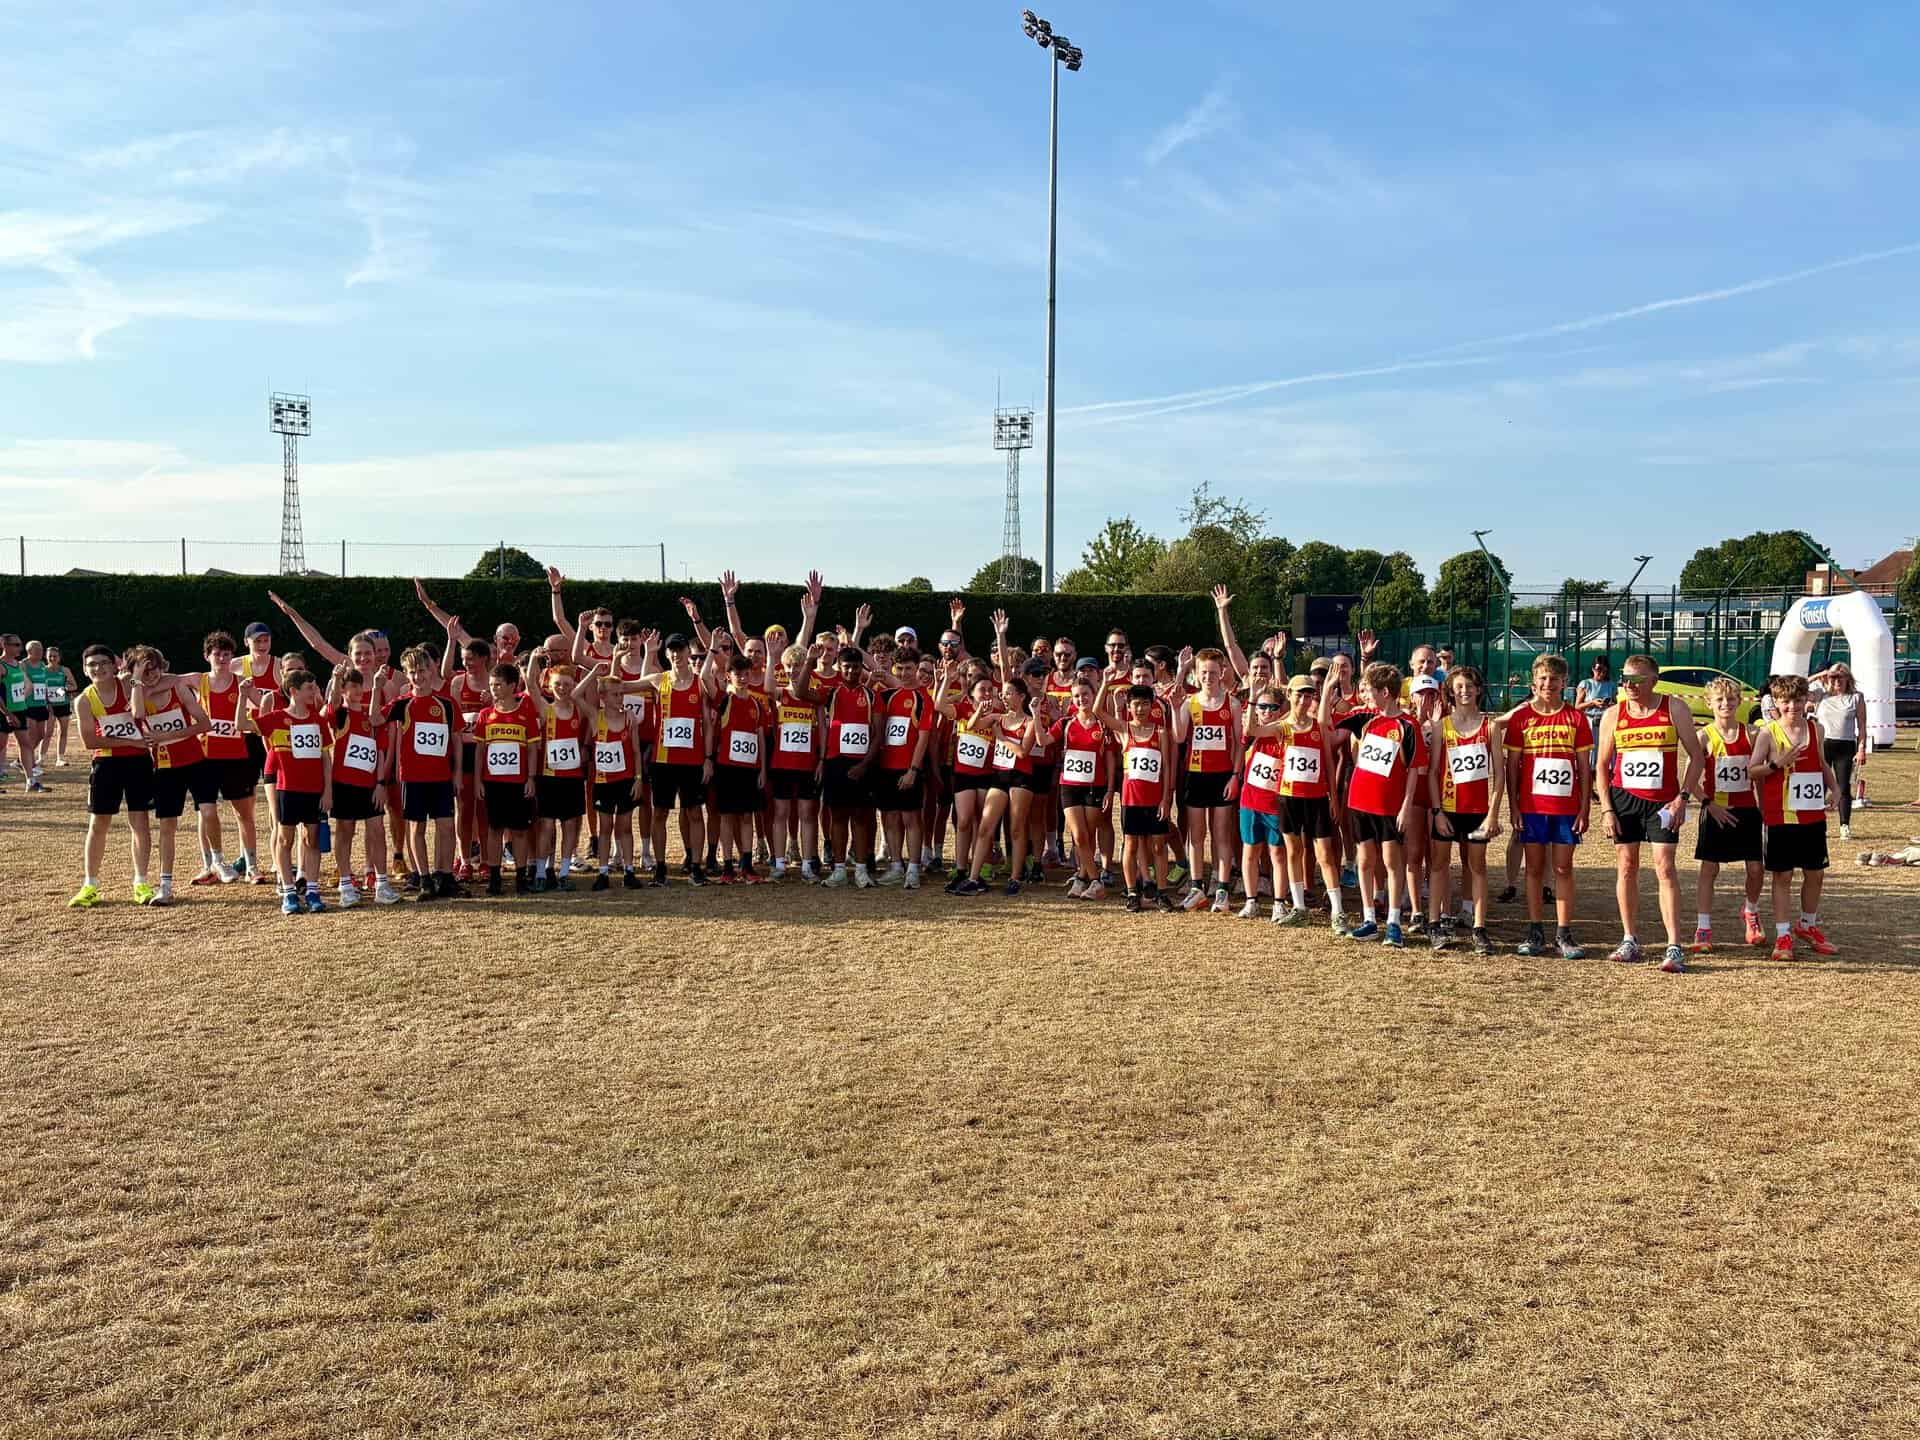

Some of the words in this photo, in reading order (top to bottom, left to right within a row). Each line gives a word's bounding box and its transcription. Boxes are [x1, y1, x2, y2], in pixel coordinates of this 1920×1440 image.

[104, 722, 136, 737] 228
[491, 727, 520, 736] EPSOM
[666, 726, 692, 740] 128
[783, 730, 809, 744] 125
[1195, 727, 1223, 741] 334
[1530, 730, 1569, 741] EPSOM
[1621, 731, 1666, 742] EPSOM
[294, 734, 320, 748] 333
[417, 731, 445, 747] 331
[842, 732, 867, 745] 426
[348, 744, 377, 763] 233
[550, 747, 576, 762] 131
[732, 740, 757, 754] 330
[959, 742, 985, 759] 239
[489, 752, 518, 766] 332
[596, 750, 621, 764] 231
[1361, 744, 1393, 766] 234
[1066, 759, 1093, 774] 238
[1131, 757, 1158, 773] 133
[1287, 757, 1318, 773] 134
[1452, 754, 1486, 773] 232
[1623, 762, 1661, 777] 322
[1252, 763, 1281, 782] 433
[1535, 769, 1571, 785] 432
[1717, 766, 1748, 782] 431
[1792, 783, 1822, 799] 132
